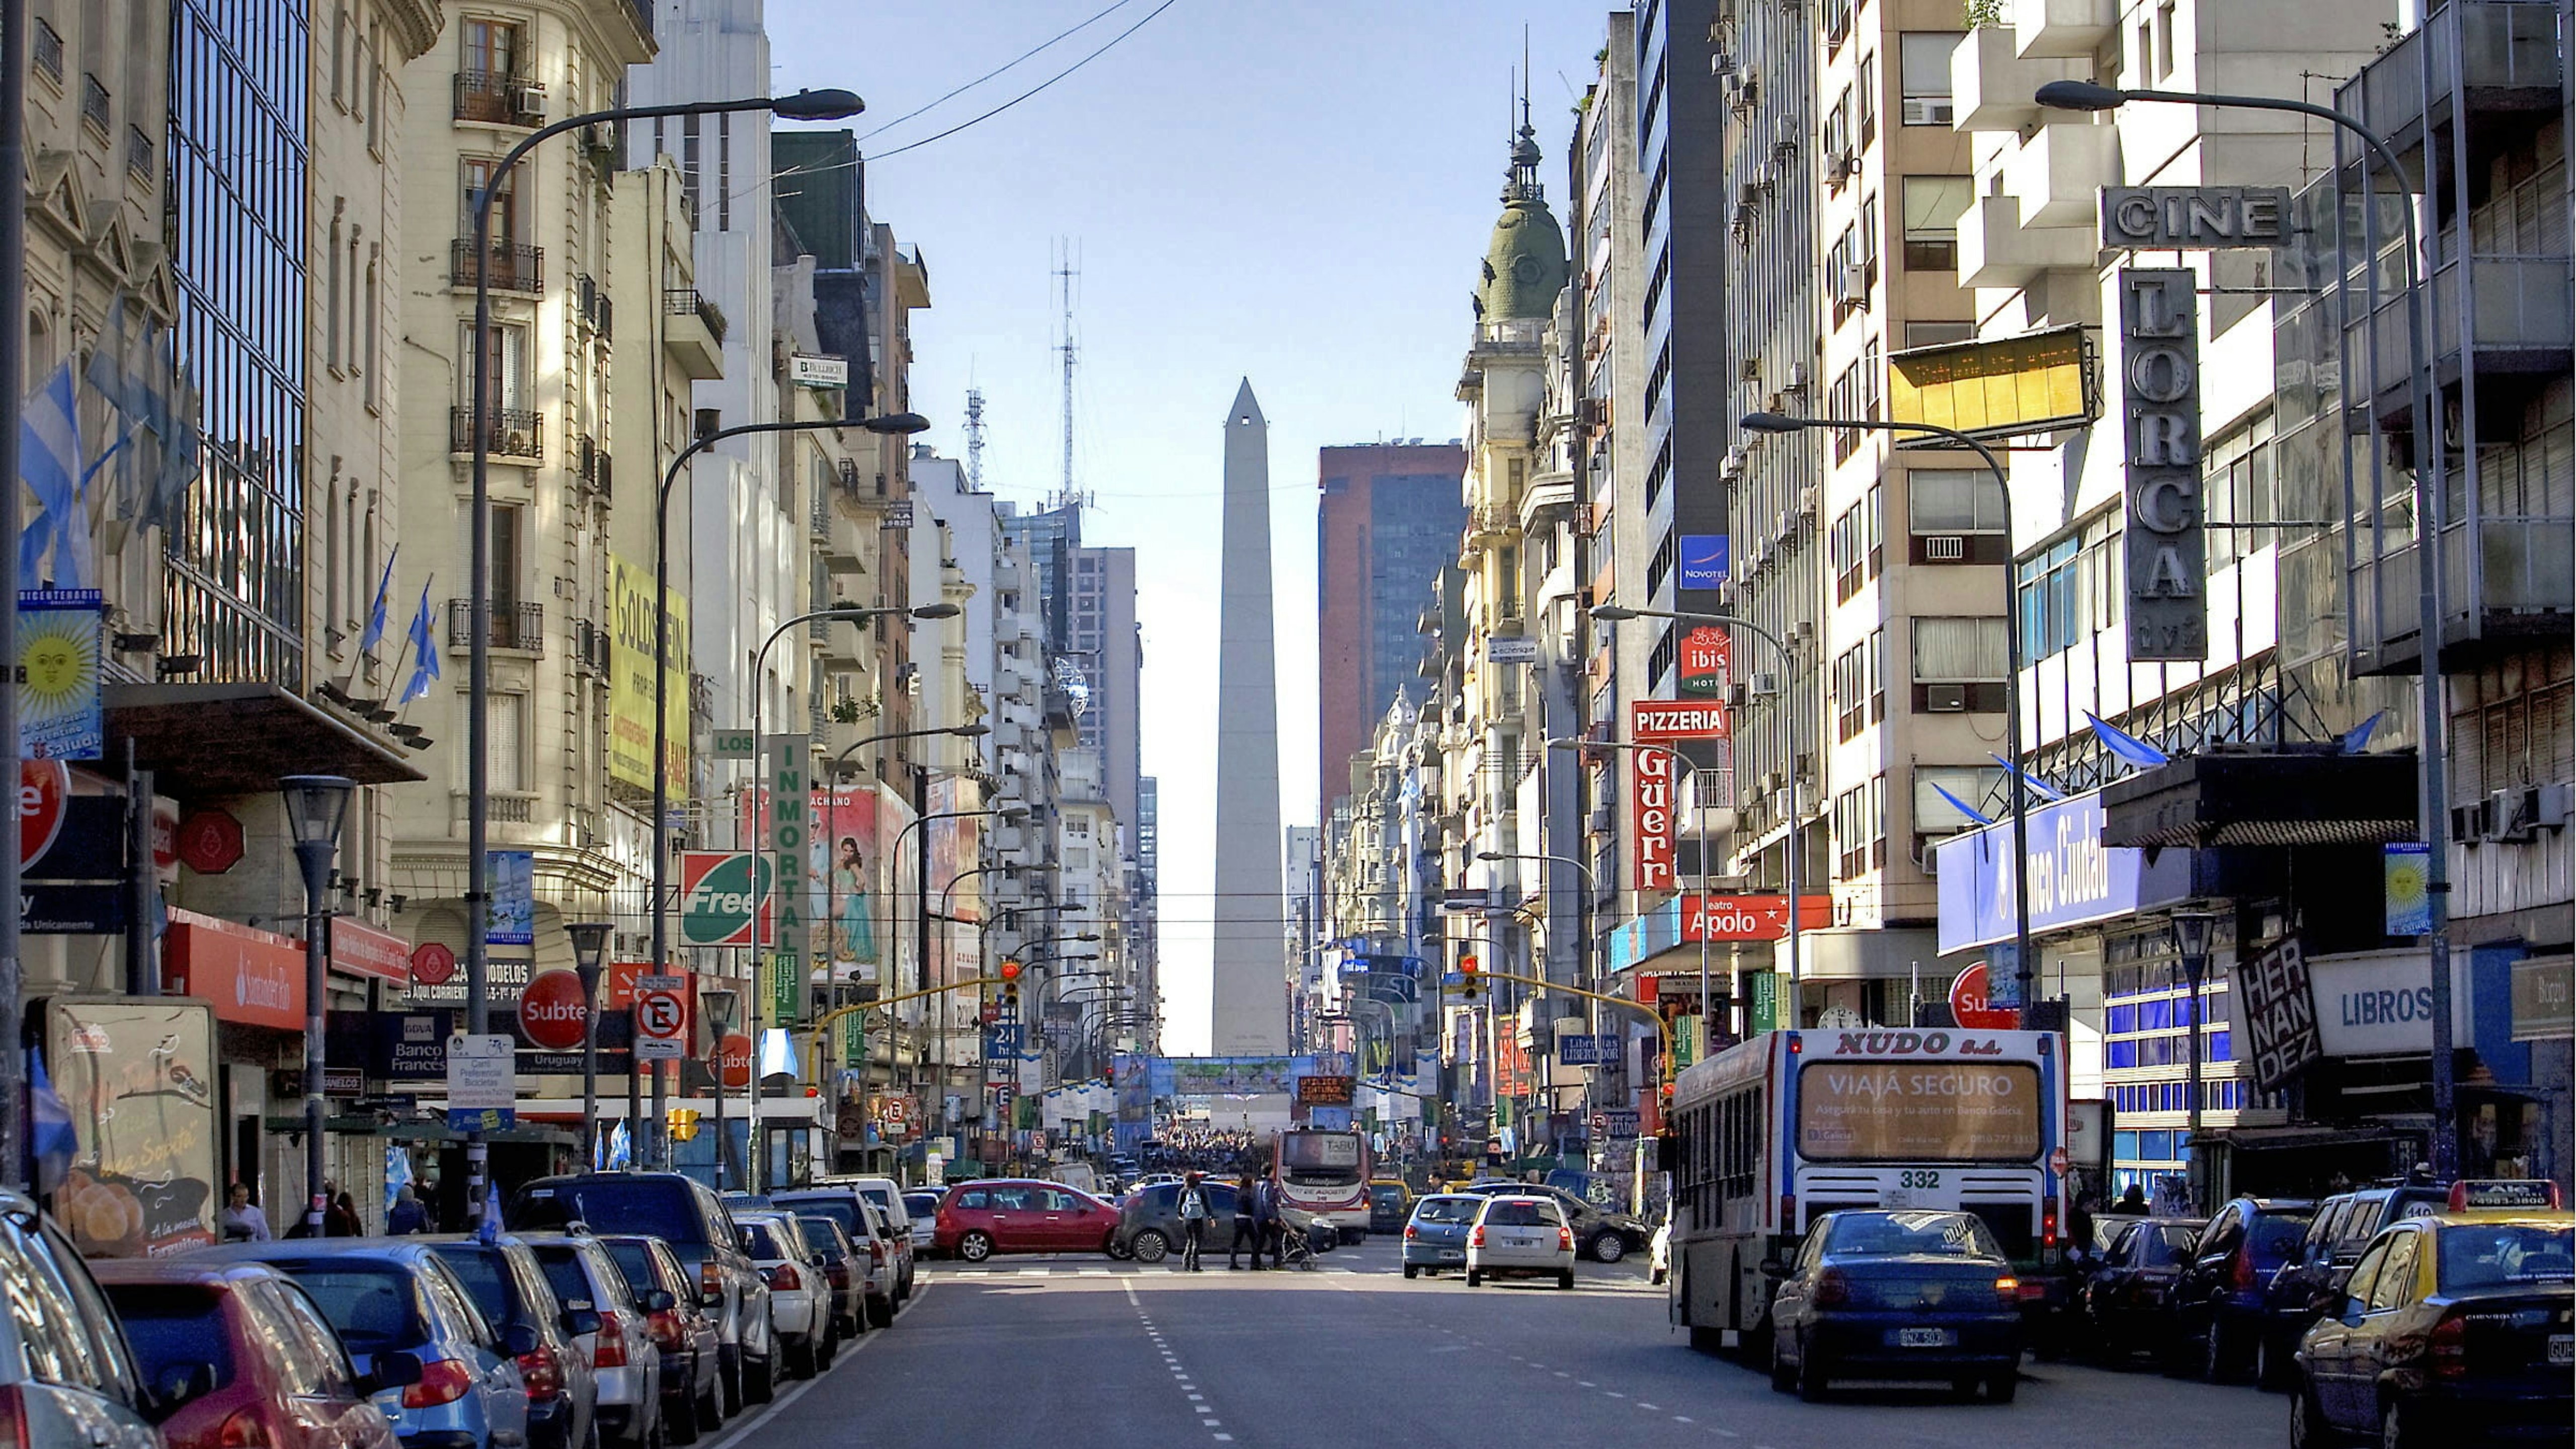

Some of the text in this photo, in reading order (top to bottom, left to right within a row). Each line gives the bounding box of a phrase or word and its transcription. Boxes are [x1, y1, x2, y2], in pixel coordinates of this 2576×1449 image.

[2117, 196, 2278, 237] CINE
[2131, 281, 2194, 599] LORCA
[1685, 570, 1727, 578] NOVOTEL
[19, 590, 101, 600] BICENTENARIO
[1692, 650, 1726, 668] ibis
[1637, 710, 1722, 731] PIZZERIA
[46, 732, 100, 757] Salud!
[718, 737, 753, 751] LOS
[1637, 748, 1667, 889] Güerr
[2056, 809, 2108, 906] Ciudad
[683, 886, 753, 913] Free
[1709, 901, 1733, 909] eatro
[34, 920, 95, 930] Unicamente
[1690, 908, 1755, 938] Apolo
[2243, 945, 2305, 1011] HER
[413, 986, 430, 1001] AQUI
[431, 986, 468, 1000] CORRIENT
[527, 1001, 587, 1021] Subte
[652, 1002, 671, 1027] E
[2342, 987, 2433, 1026] LIBROS
[2252, 988, 2312, 1053] NAN
[395, 1042, 442, 1057] Banco
[1835, 1032, 1950, 1055] NUDO
[391, 1057, 447, 1072] Francés
[535, 1054, 584, 1067] Uruguay
[2258, 1031, 2317, 1085] DEZ
[1828, 1070, 2013, 1101] VIAJÁ SEGURO
[1900, 1170, 1940, 1188] 332
